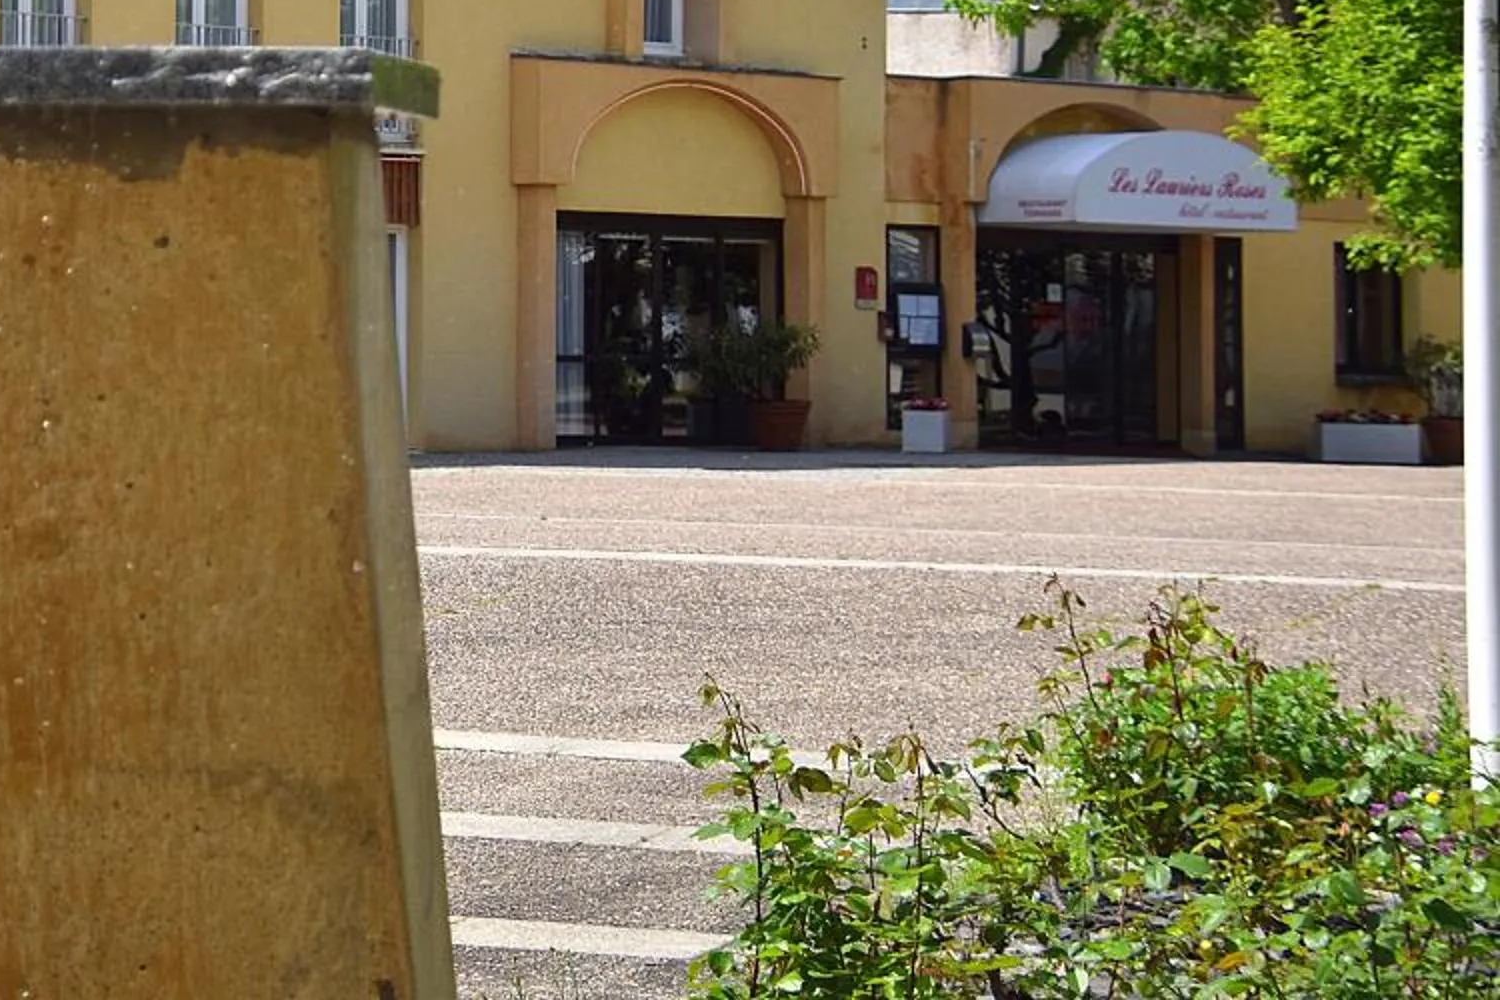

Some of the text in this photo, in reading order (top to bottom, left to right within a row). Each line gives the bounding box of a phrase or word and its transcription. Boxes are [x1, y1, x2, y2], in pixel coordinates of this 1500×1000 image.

[1108, 167, 1266, 199] Les Lauriers Roses
